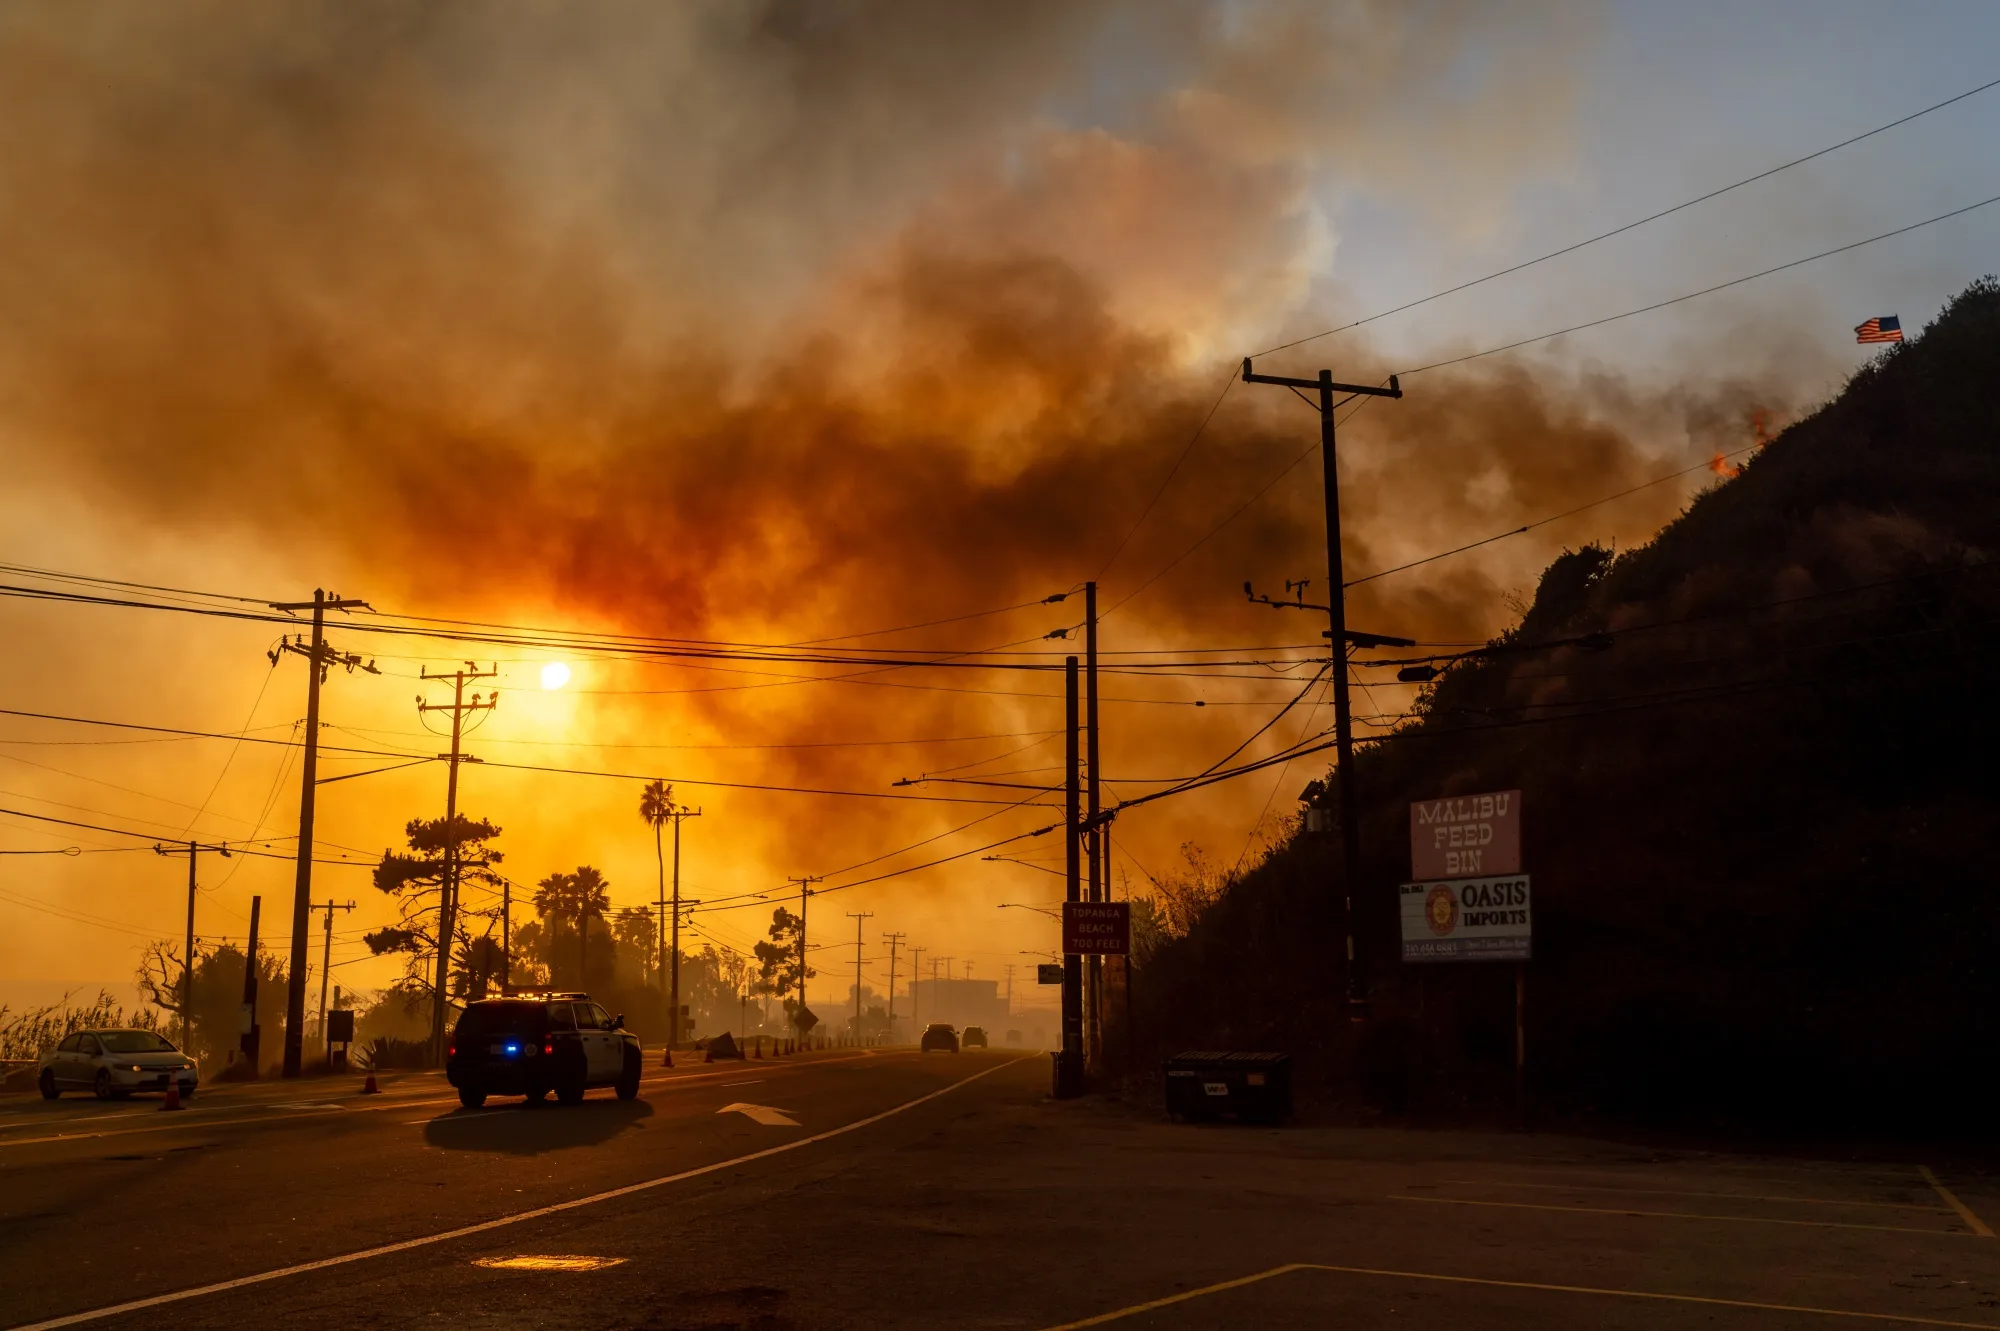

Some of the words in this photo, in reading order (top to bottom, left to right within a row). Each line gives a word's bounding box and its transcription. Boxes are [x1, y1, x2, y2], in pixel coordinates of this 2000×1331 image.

[1418, 794, 1510, 825] MALIBU
[1434, 823, 1493, 849] FEED
[1445, 849, 1482, 875] BIN
[1461, 881, 1526, 908] OASIS
[1072, 908, 1120, 919] TOPANGA
[1463, 910, 1527, 927] IMPORTS
[1078, 923, 1114, 934] BEACH
[1071, 938, 1093, 949] 700
[1096, 938, 1121, 949] FEET
